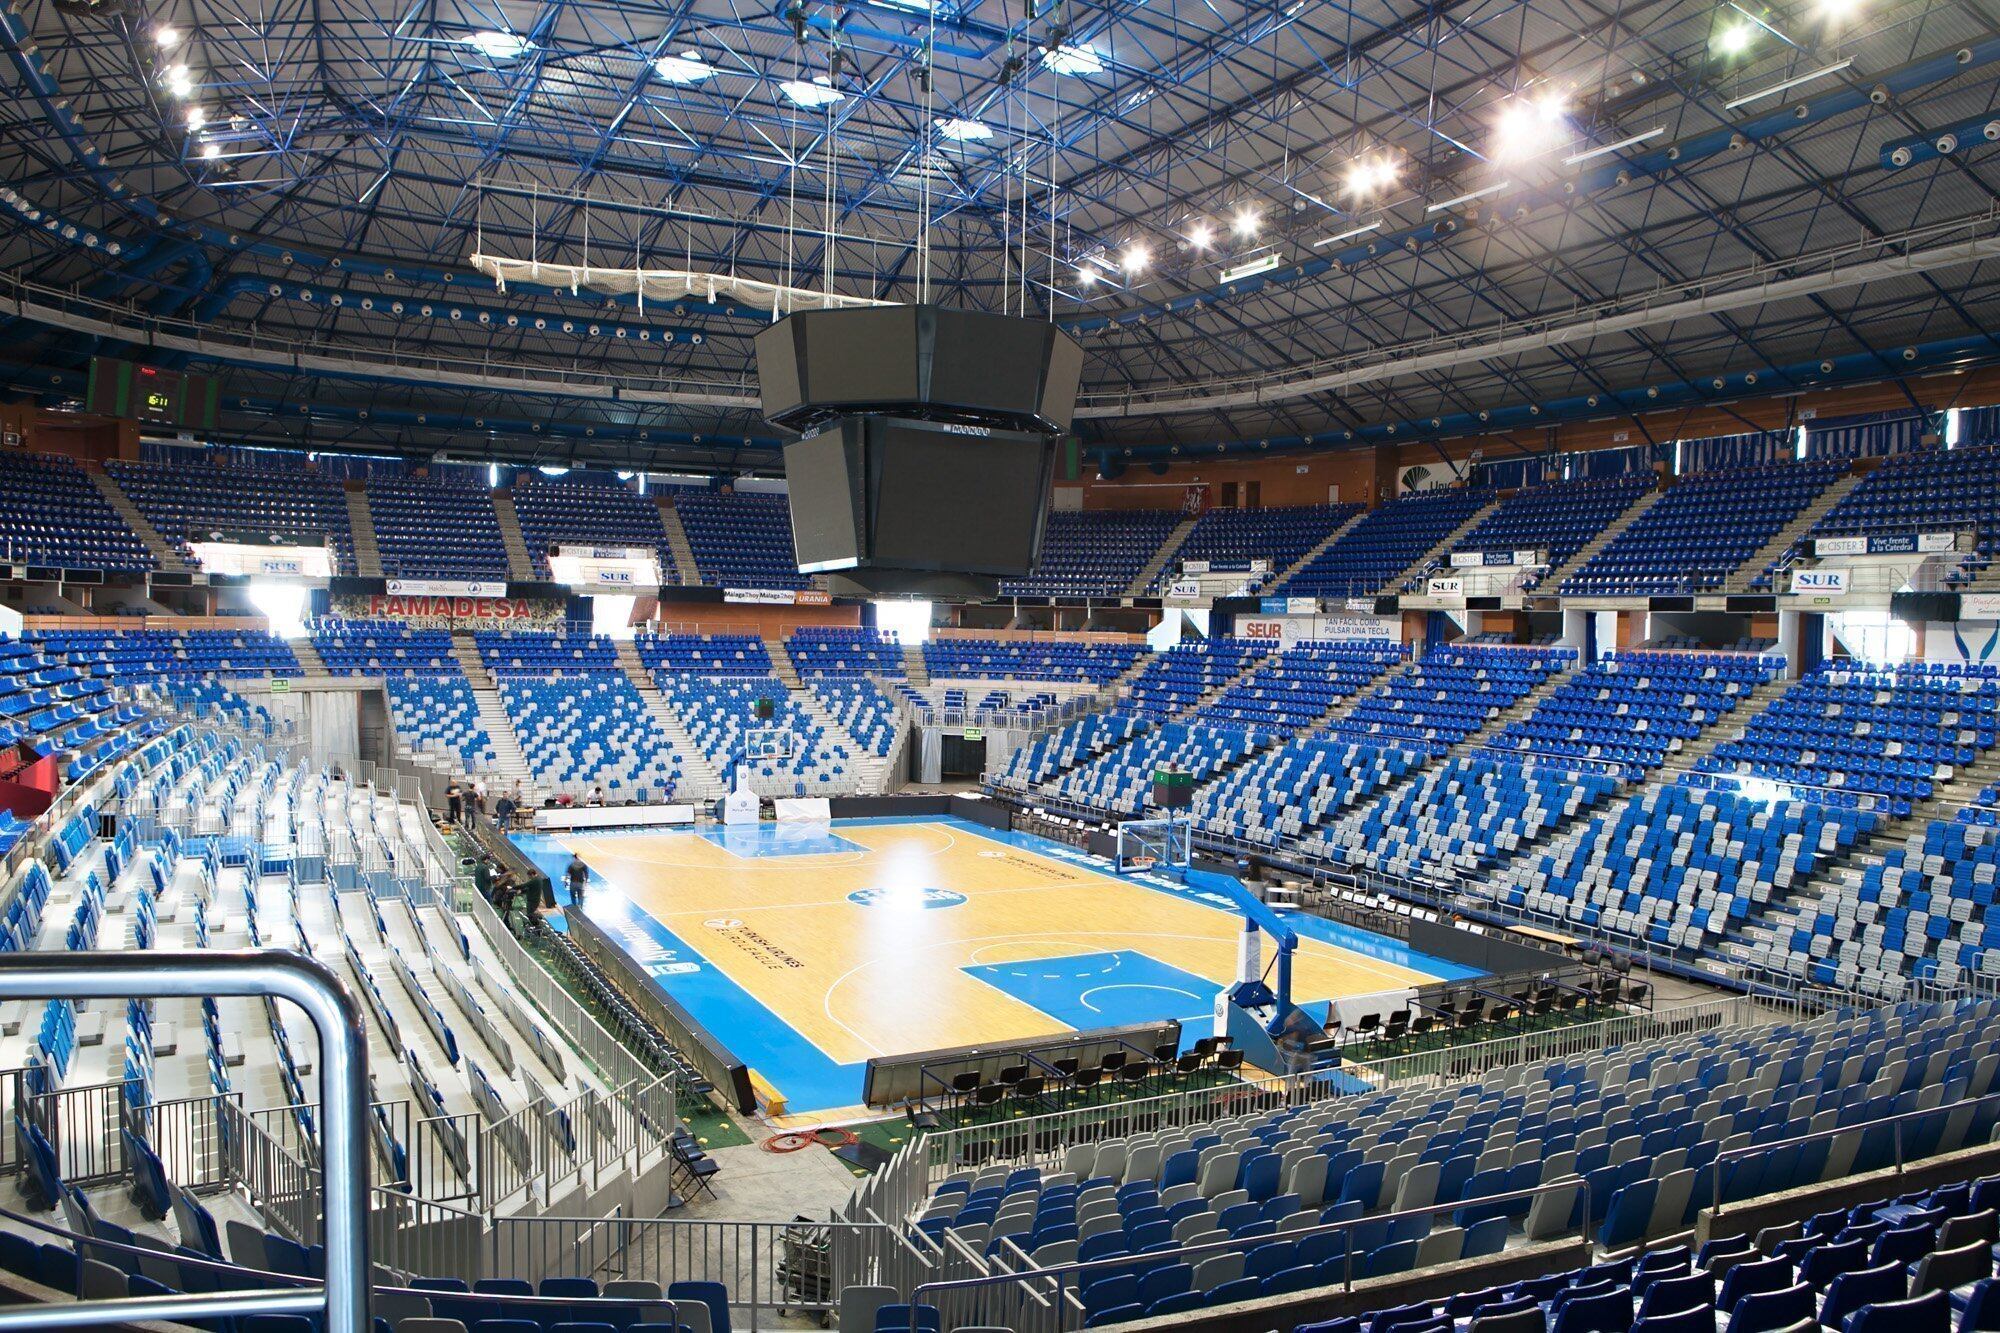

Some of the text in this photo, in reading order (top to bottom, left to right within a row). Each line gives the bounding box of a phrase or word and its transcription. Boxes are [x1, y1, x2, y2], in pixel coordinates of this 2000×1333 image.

[952, 425, 990, 436] MONDO
[1827, 540, 1865, 552] CISTER 3
[1888, 537, 1910, 545] frente
[1885, 542, 1914, 552] Catedral
[601, 573, 629, 581] SUR
[1799, 574, 1841, 586] SUR
[1432, 582, 1458, 590] SUR
[370, 595, 531, 619] FAMADESA
[1325, 617, 1338, 626] TAN
[1360, 618, 1380, 627] COMO
[1246, 623, 1282, 638] SEUR
[1324, 626, 1390, 635] PULSAR UNA TECLA
